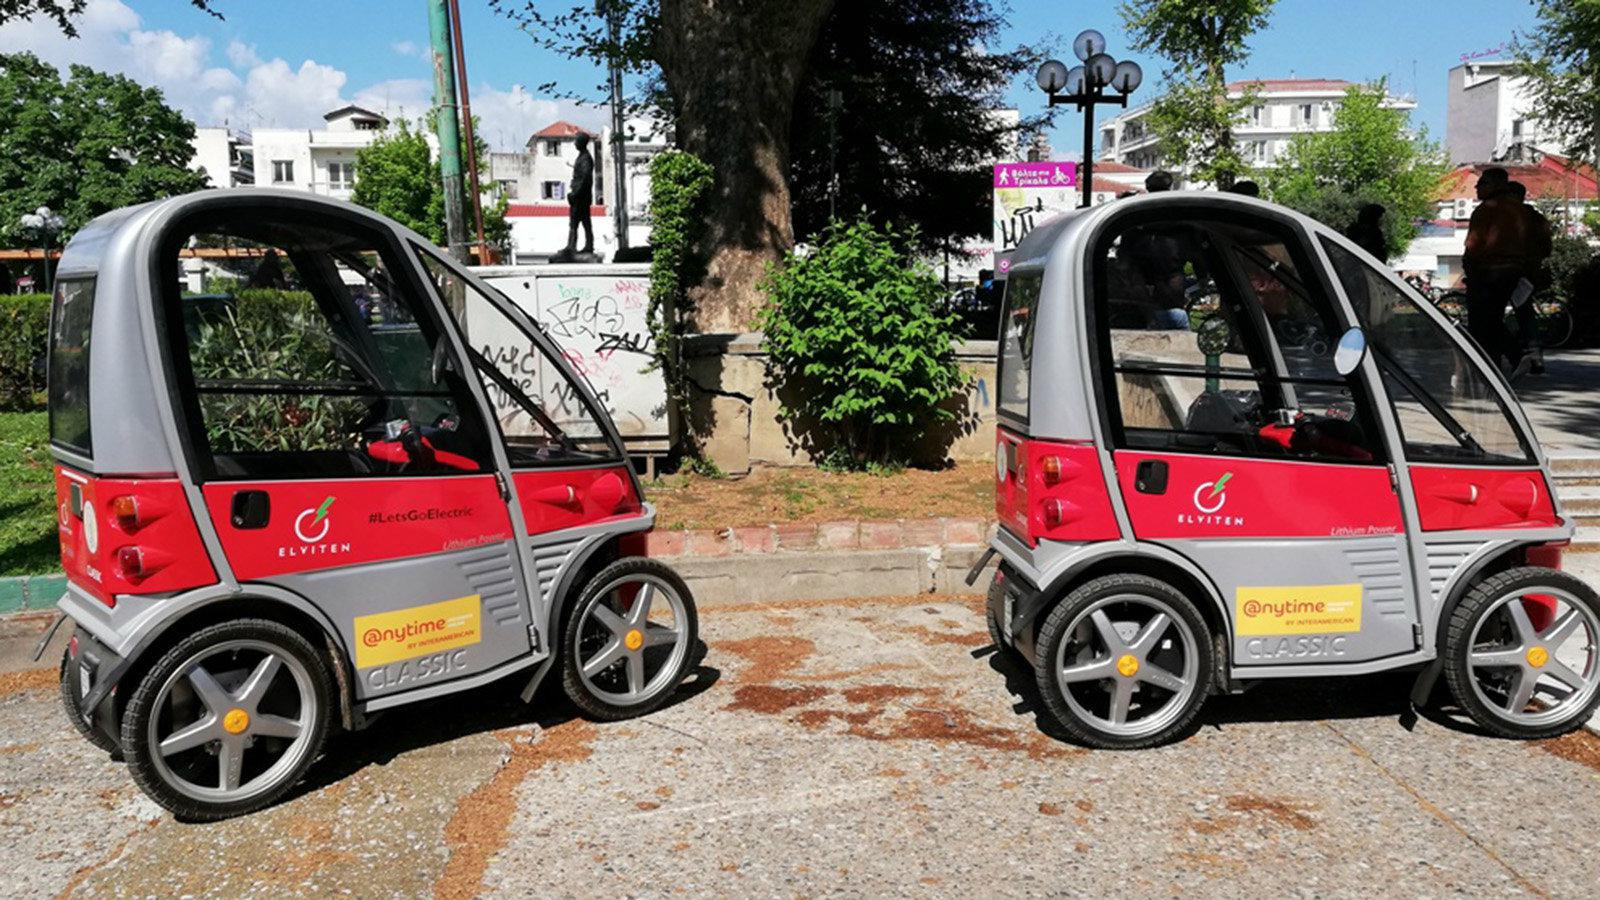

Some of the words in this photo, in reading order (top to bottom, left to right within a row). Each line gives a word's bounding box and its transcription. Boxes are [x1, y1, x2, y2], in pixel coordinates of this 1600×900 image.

[368, 506, 473, 524] #LetsGoElectric
[1177, 514, 1244, 526] ELVITEN
[1329, 526, 1365, 537] Lithium
[1367, 524, 1397, 535] Power
[278, 542, 351, 557] ELVITEN
[442, 537, 476, 551] Lithium
[1243, 599, 1325, 618] @nytime
[363, 618, 446, 648] @nytime
[1246, 635, 1346, 659] CLASSIC
[367, 648, 467, 689] CLASSIC
